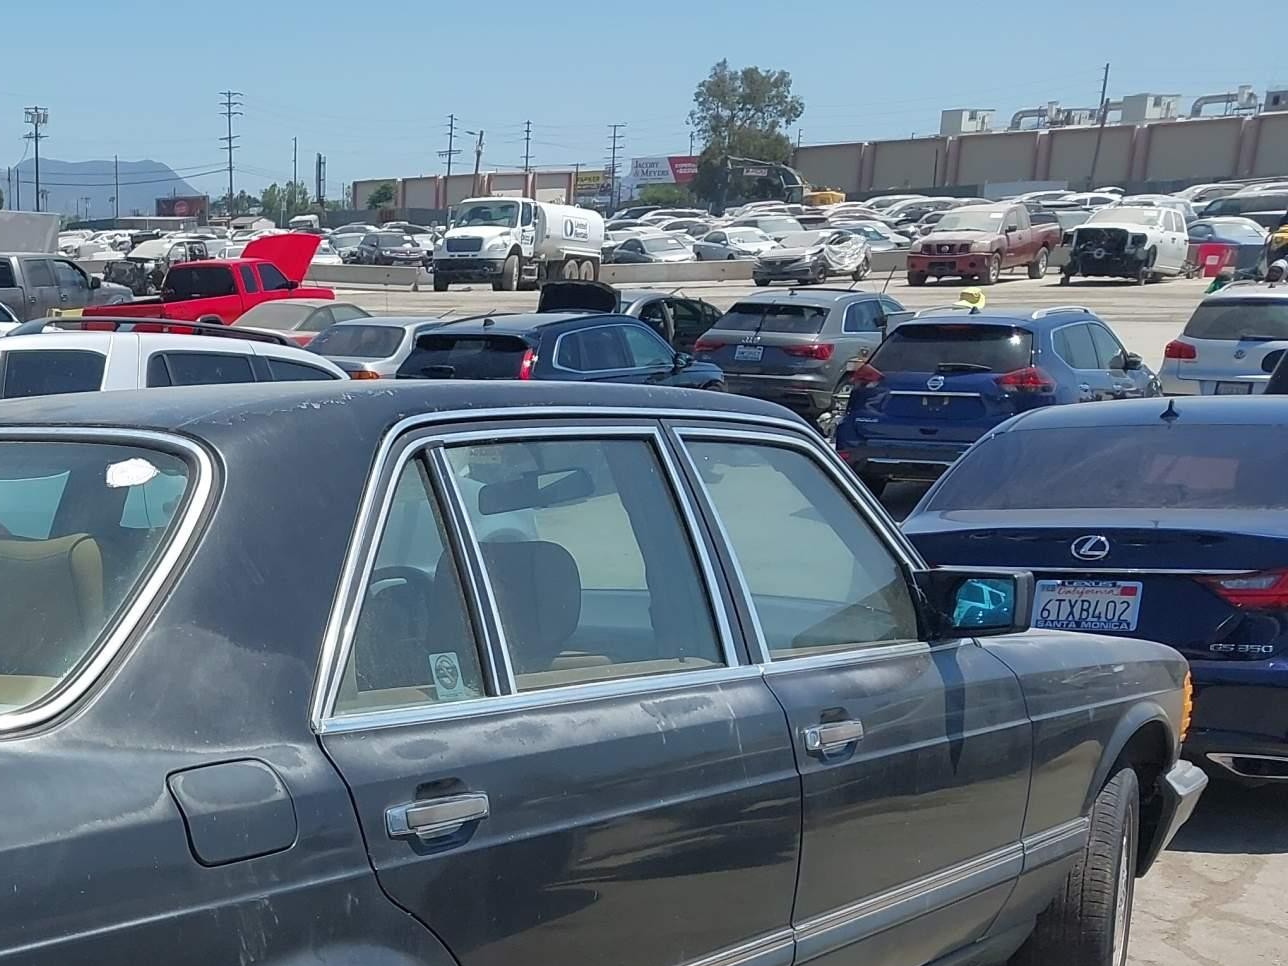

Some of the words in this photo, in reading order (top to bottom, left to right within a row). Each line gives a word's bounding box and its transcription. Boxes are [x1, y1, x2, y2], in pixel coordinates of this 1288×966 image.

[1064, 580, 1115, 588] LEXUS
[1056, 586, 1116, 597] California
[1039, 598, 1131, 622] 6TXB402
[1037, 620, 1077, 629] SANTA
[1080, 621, 1130, 630] MONICA
